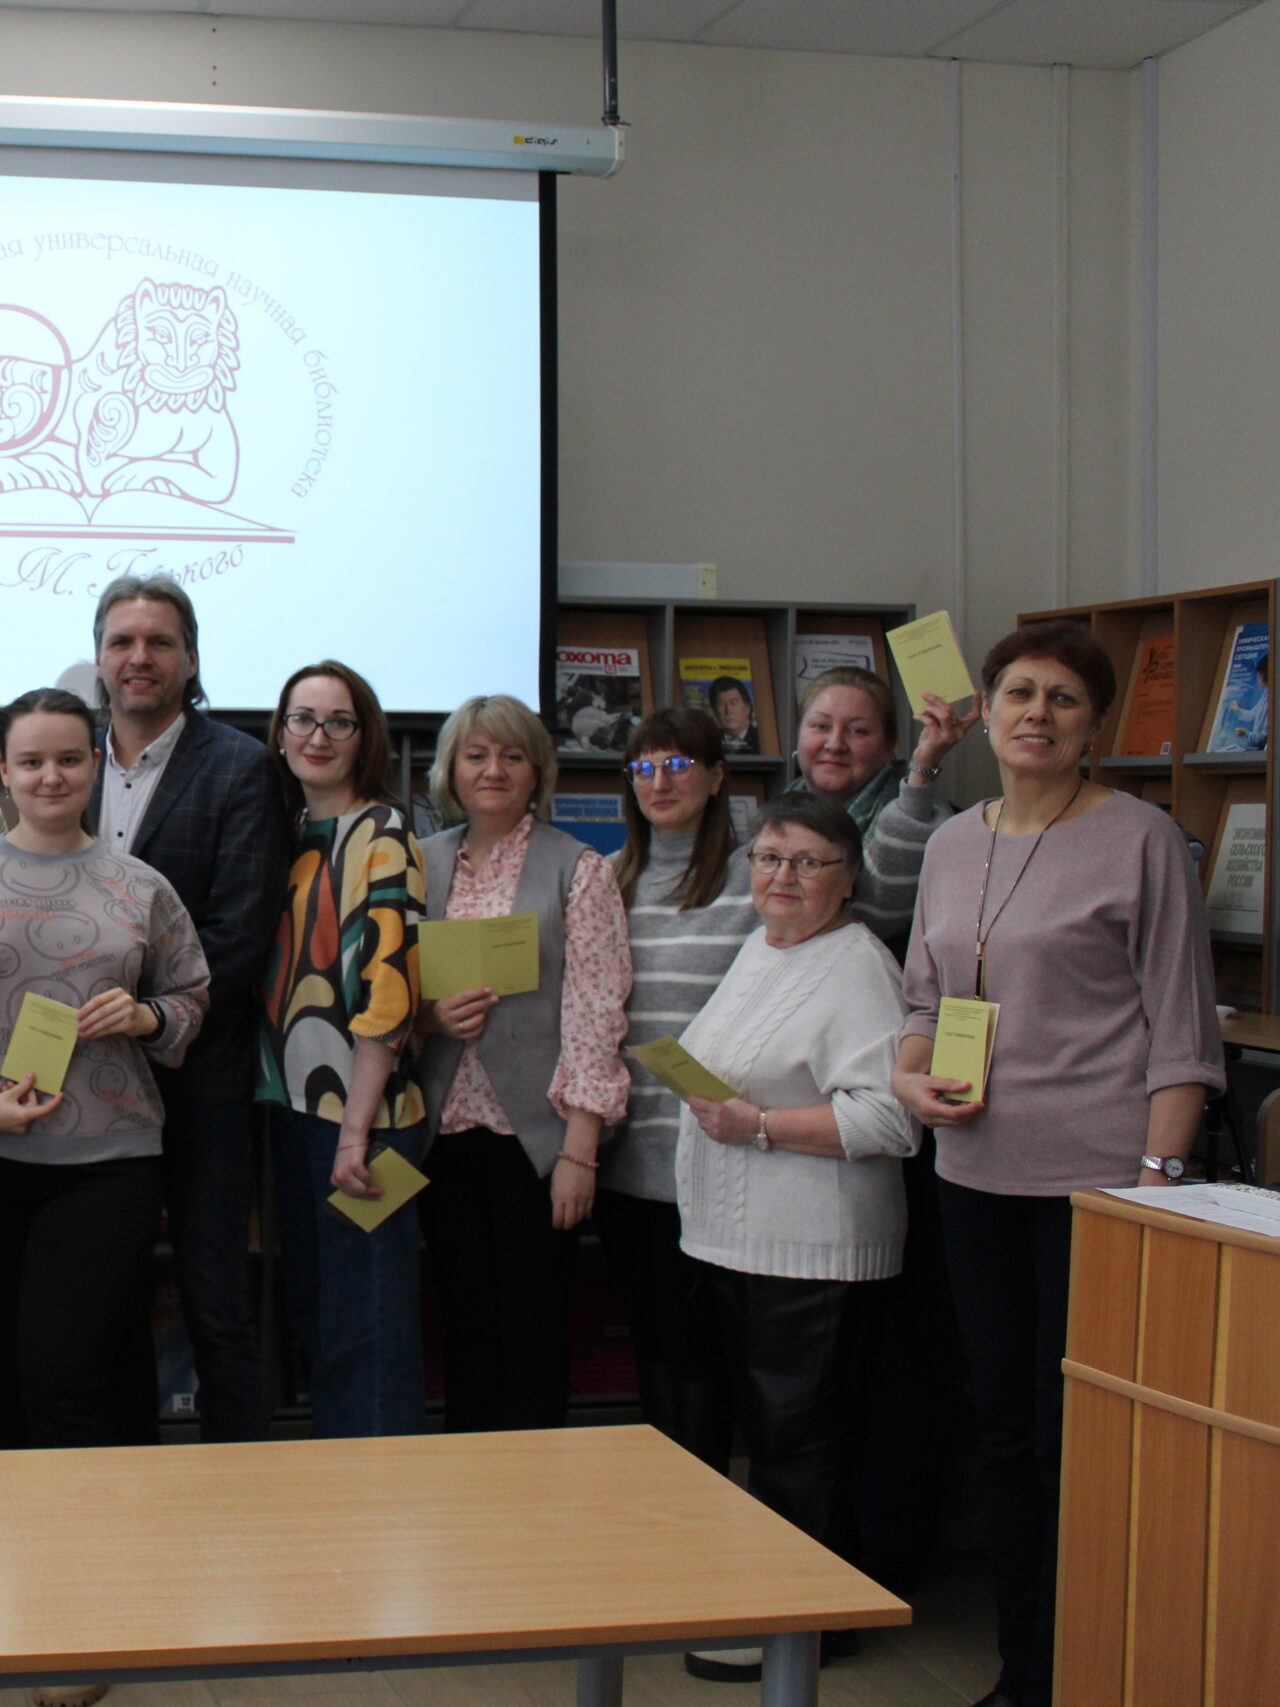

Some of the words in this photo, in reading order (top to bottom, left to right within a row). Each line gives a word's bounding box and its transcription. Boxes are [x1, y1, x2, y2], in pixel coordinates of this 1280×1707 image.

[33, 233, 220, 278] универсальная
[226, 271, 307, 345] научная
[290, 349, 339, 498] библиотека
[88, 544, 244, 597] Гького
